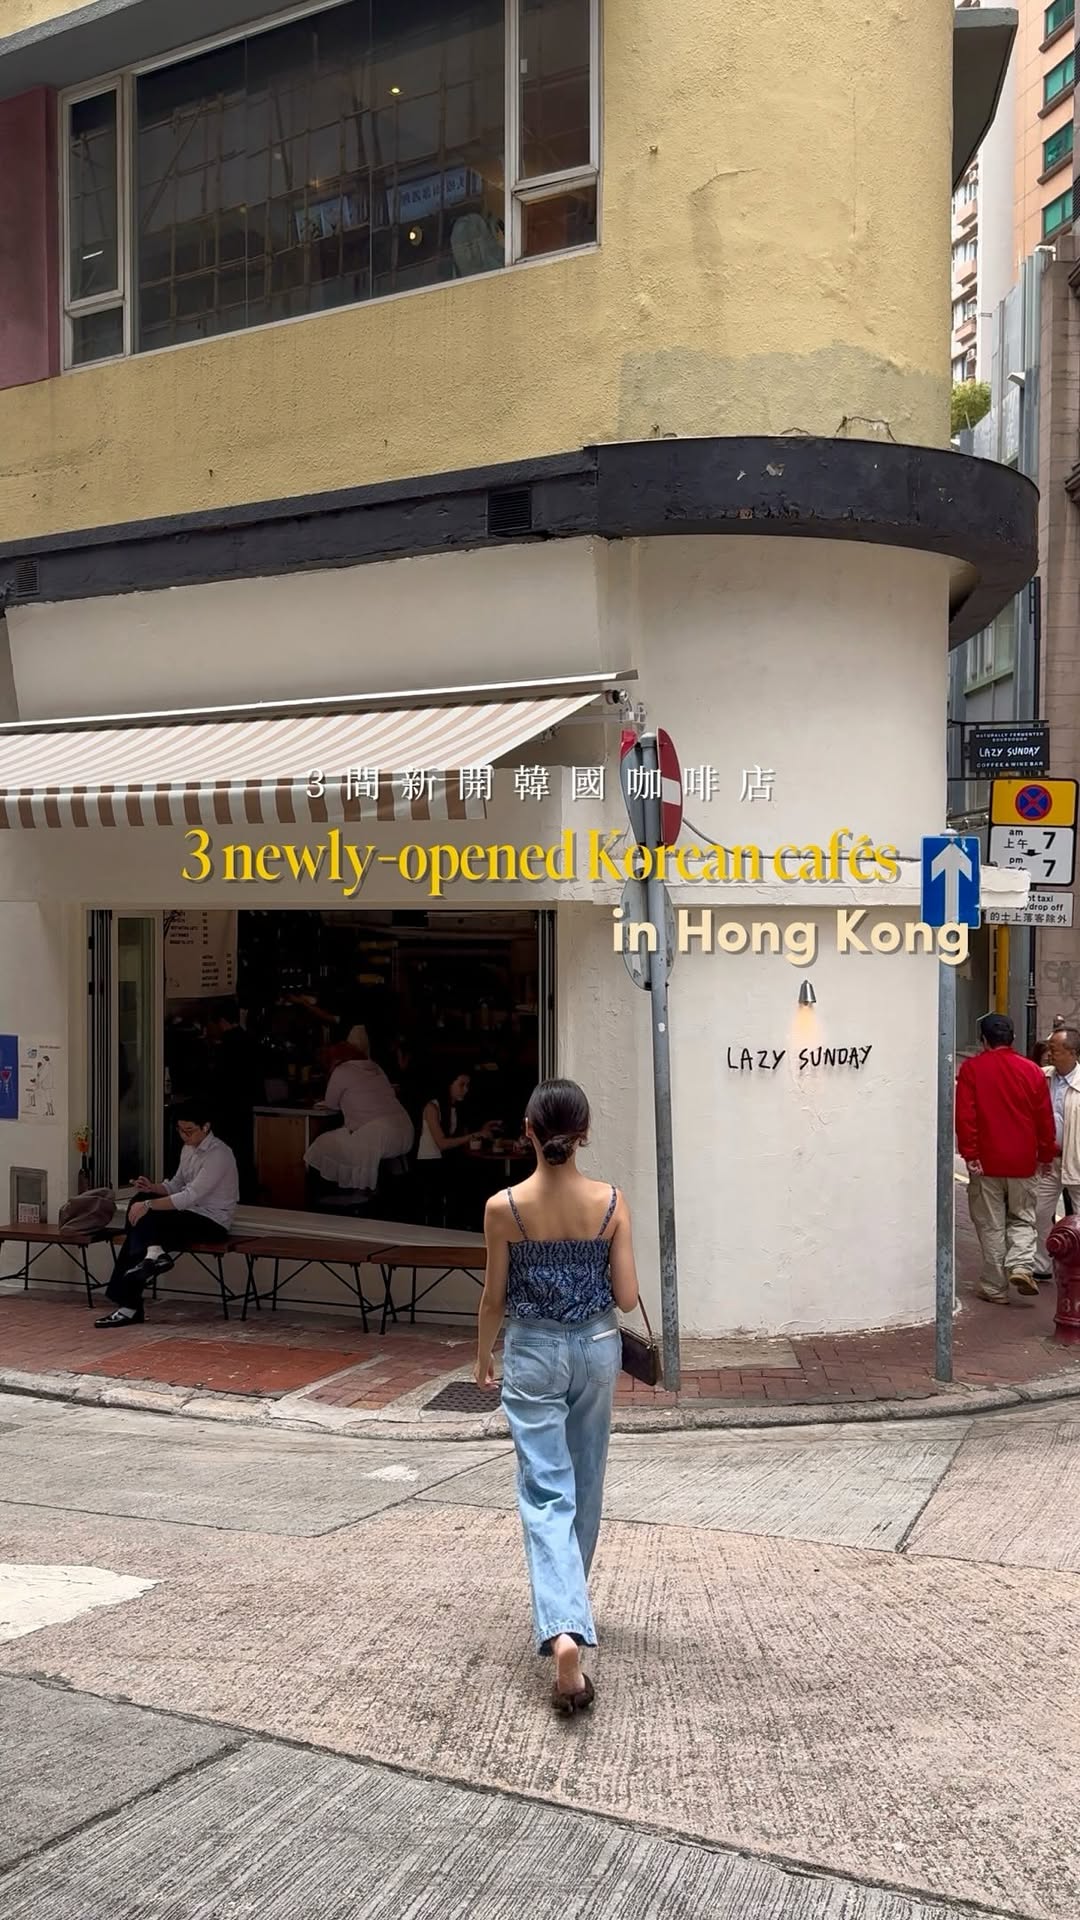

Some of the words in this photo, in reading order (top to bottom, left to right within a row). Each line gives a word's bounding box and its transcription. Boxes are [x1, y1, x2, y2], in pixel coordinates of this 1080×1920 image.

[979, 747, 1003, 758] LAZY
[1007, 746, 1040, 757] SUNDAY
[1003, 838, 1028, 849] 上午
[1043, 832, 1056, 849] 7
[1043, 860, 1056, 877] 7
[1037, 894, 1054, 903] taxi
[990, 911, 1067, 924] 的士上落客除外
[727, 1046, 786, 1070] LAZY
[799, 1045, 872, 1070] SUNDAY
